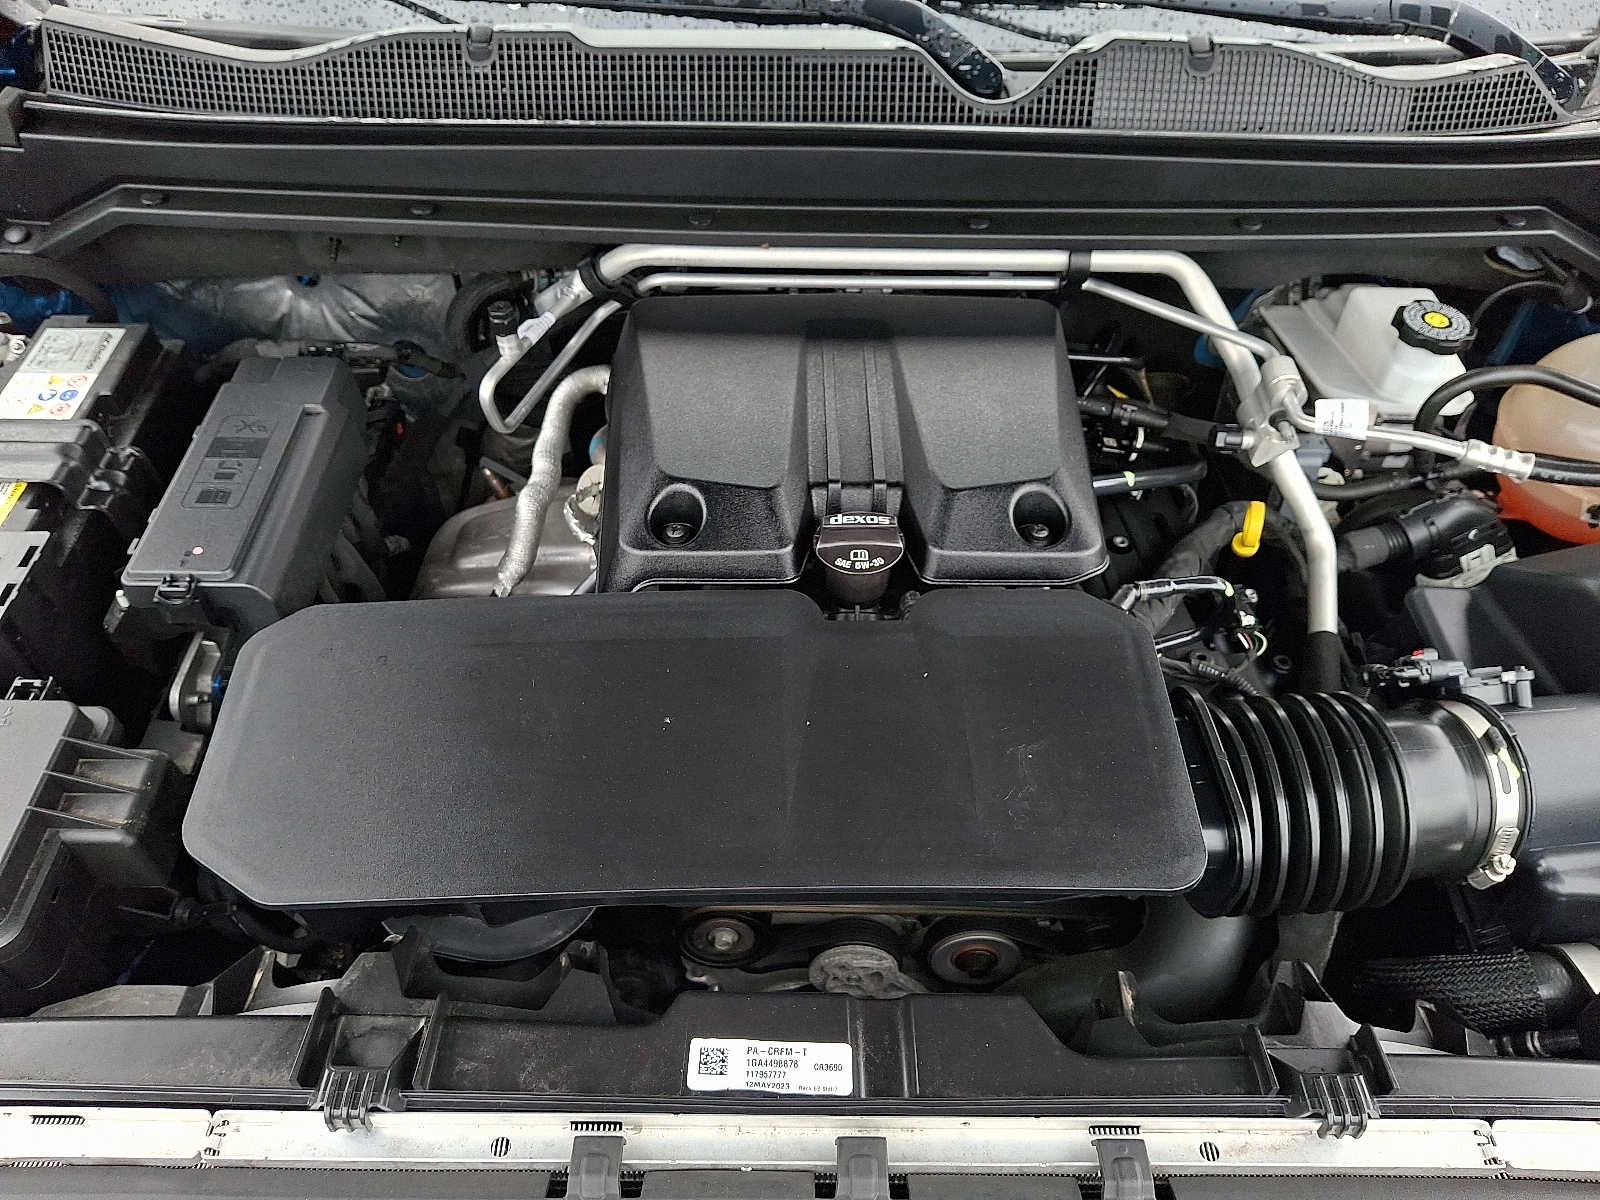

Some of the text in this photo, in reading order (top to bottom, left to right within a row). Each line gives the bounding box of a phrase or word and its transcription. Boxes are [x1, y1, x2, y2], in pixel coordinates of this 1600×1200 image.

[829, 513, 891, 525] dexos
[834, 557, 852, 569] SAE
[813, 1063, 843, 1072] CA3690
[745, 1081, 790, 1090] 12MAY2023
